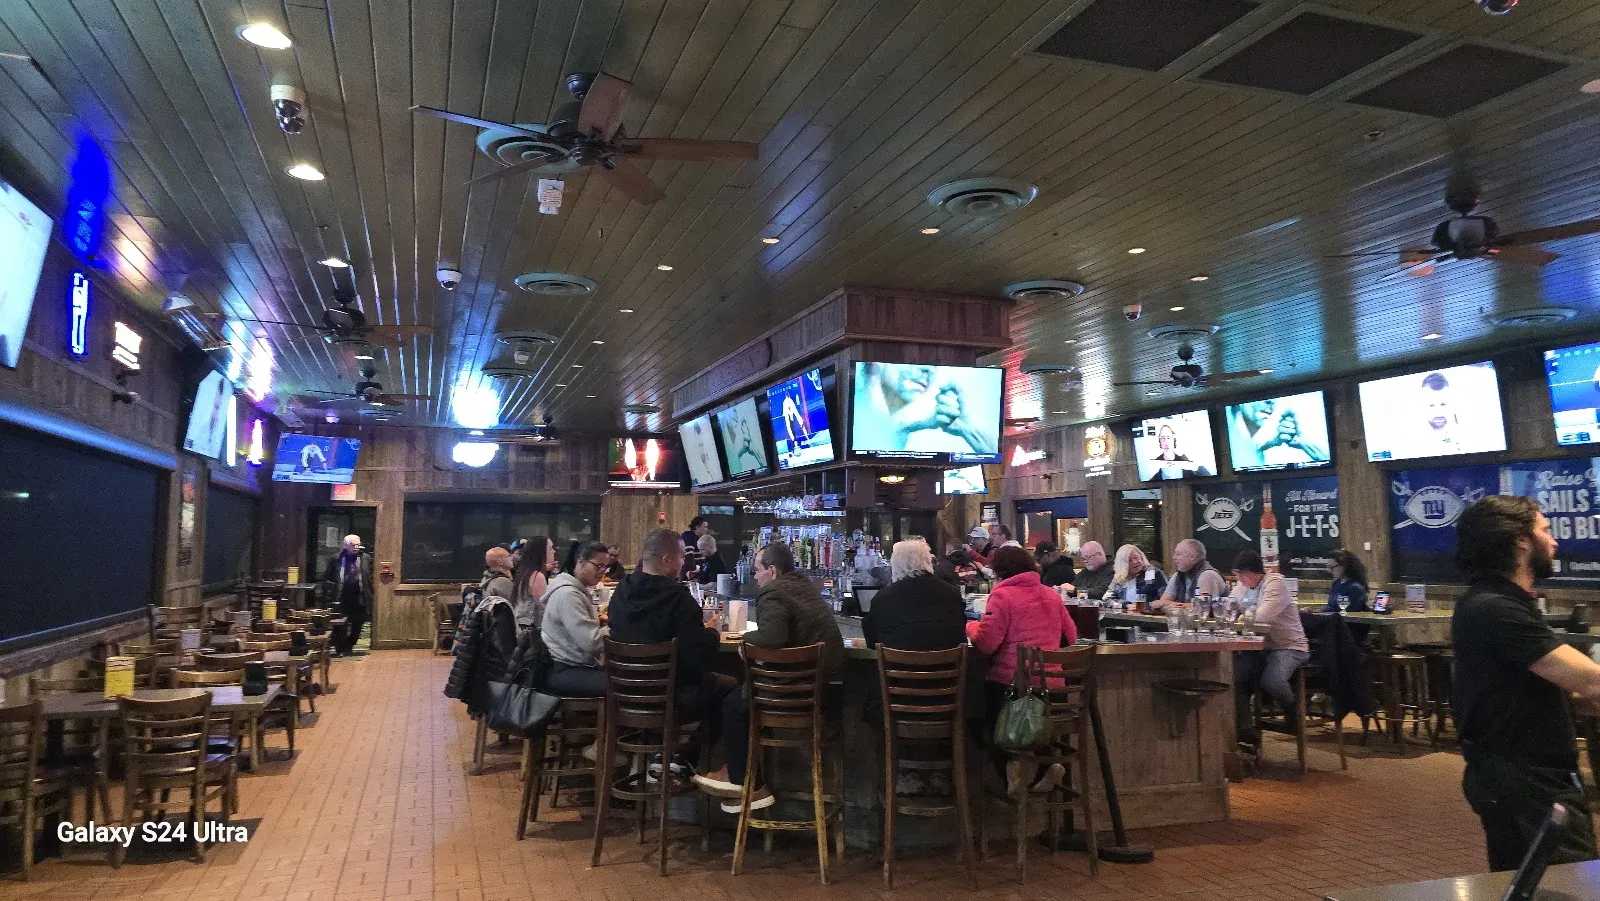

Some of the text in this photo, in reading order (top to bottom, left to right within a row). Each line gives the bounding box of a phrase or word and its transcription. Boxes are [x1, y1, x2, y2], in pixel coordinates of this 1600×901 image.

[1293, 503, 1329, 513] FOR THE
[1537, 489, 1590, 512] SAILS
[1210, 510, 1234, 520] JETS
[1575, 516, 1600, 540] BL
